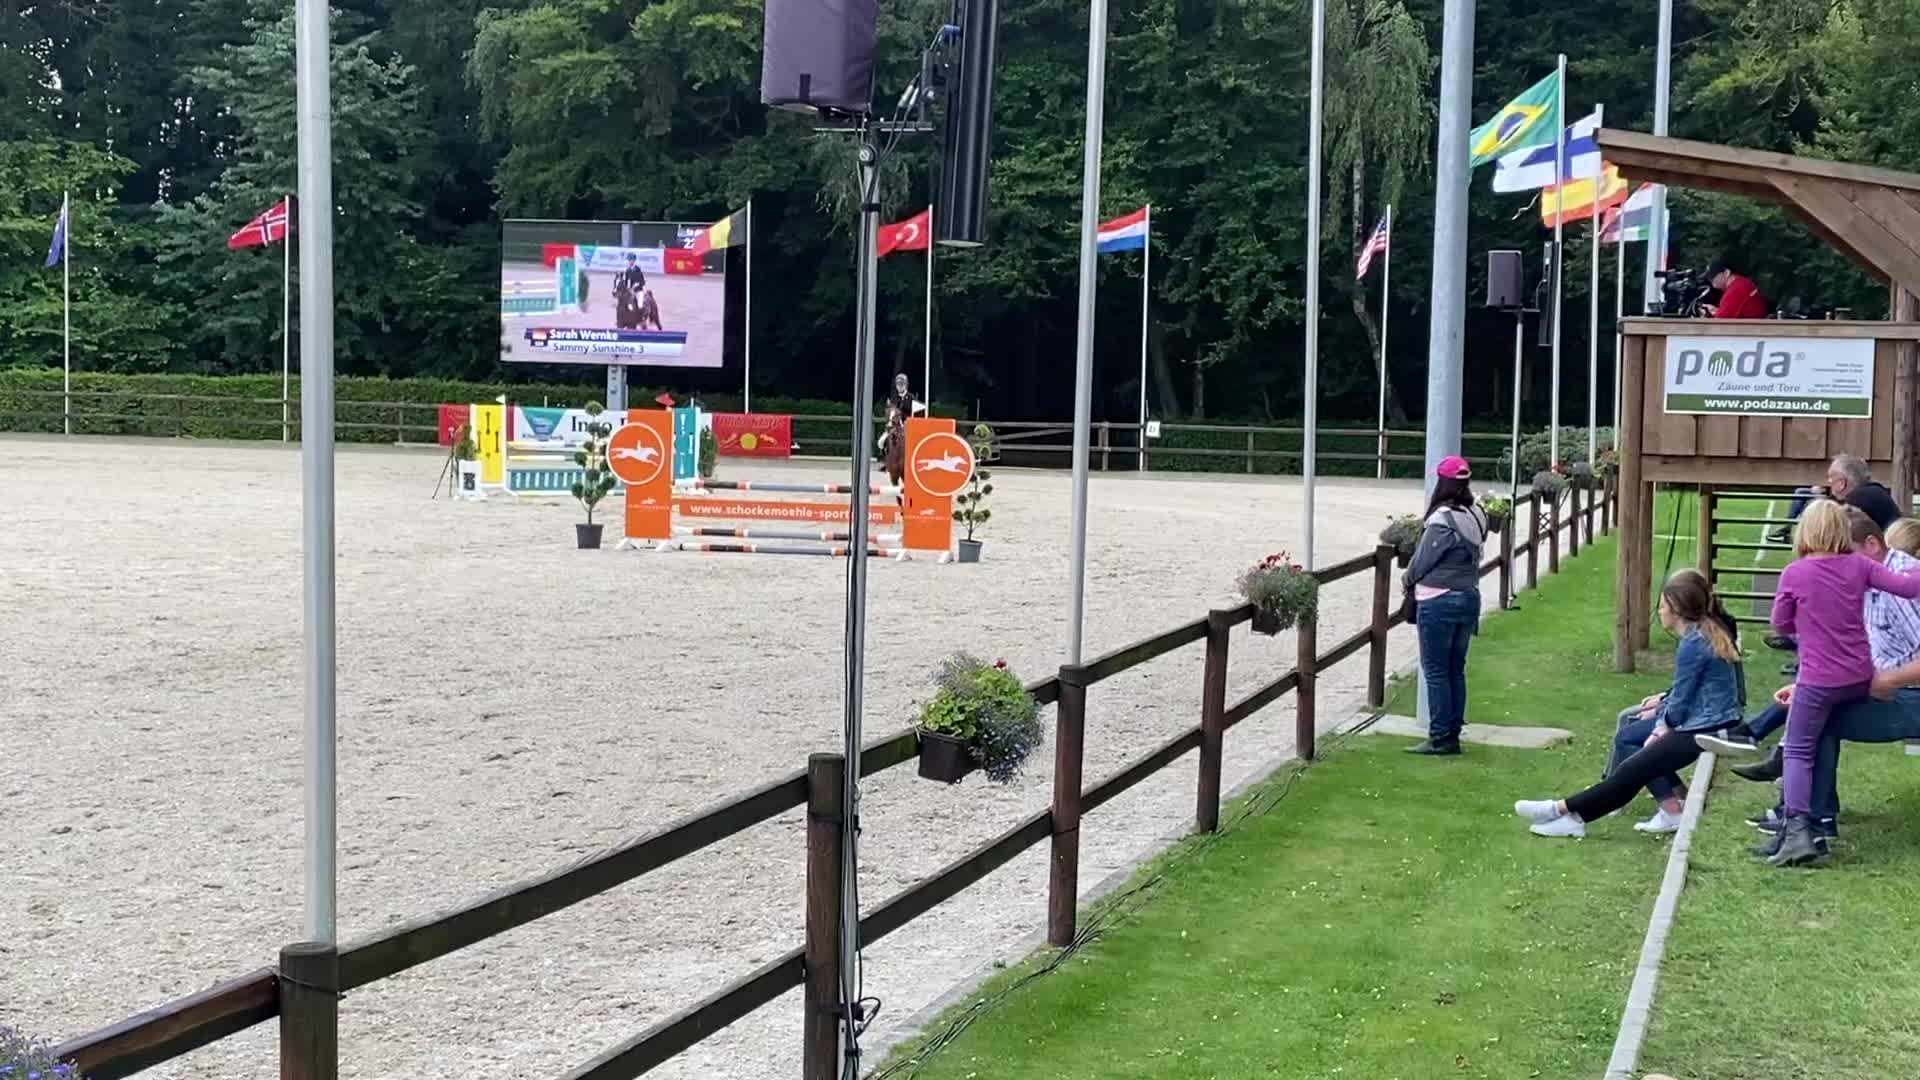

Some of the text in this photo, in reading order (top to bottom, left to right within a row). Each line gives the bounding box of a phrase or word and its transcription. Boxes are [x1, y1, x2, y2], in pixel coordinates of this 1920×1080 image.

[550, 328, 618, 341] Sarah Wernke
[553, 342, 589, 354] Sammy
[592, 343, 635, 354] Sunshine
[638, 345, 644, 354] 3
[1675, 341, 1791, 385] poda
[1753, 381, 1774, 392] und
[1777, 382, 1801, 393] Tore
[1704, 397, 1831, 411] www.podazaun.de
